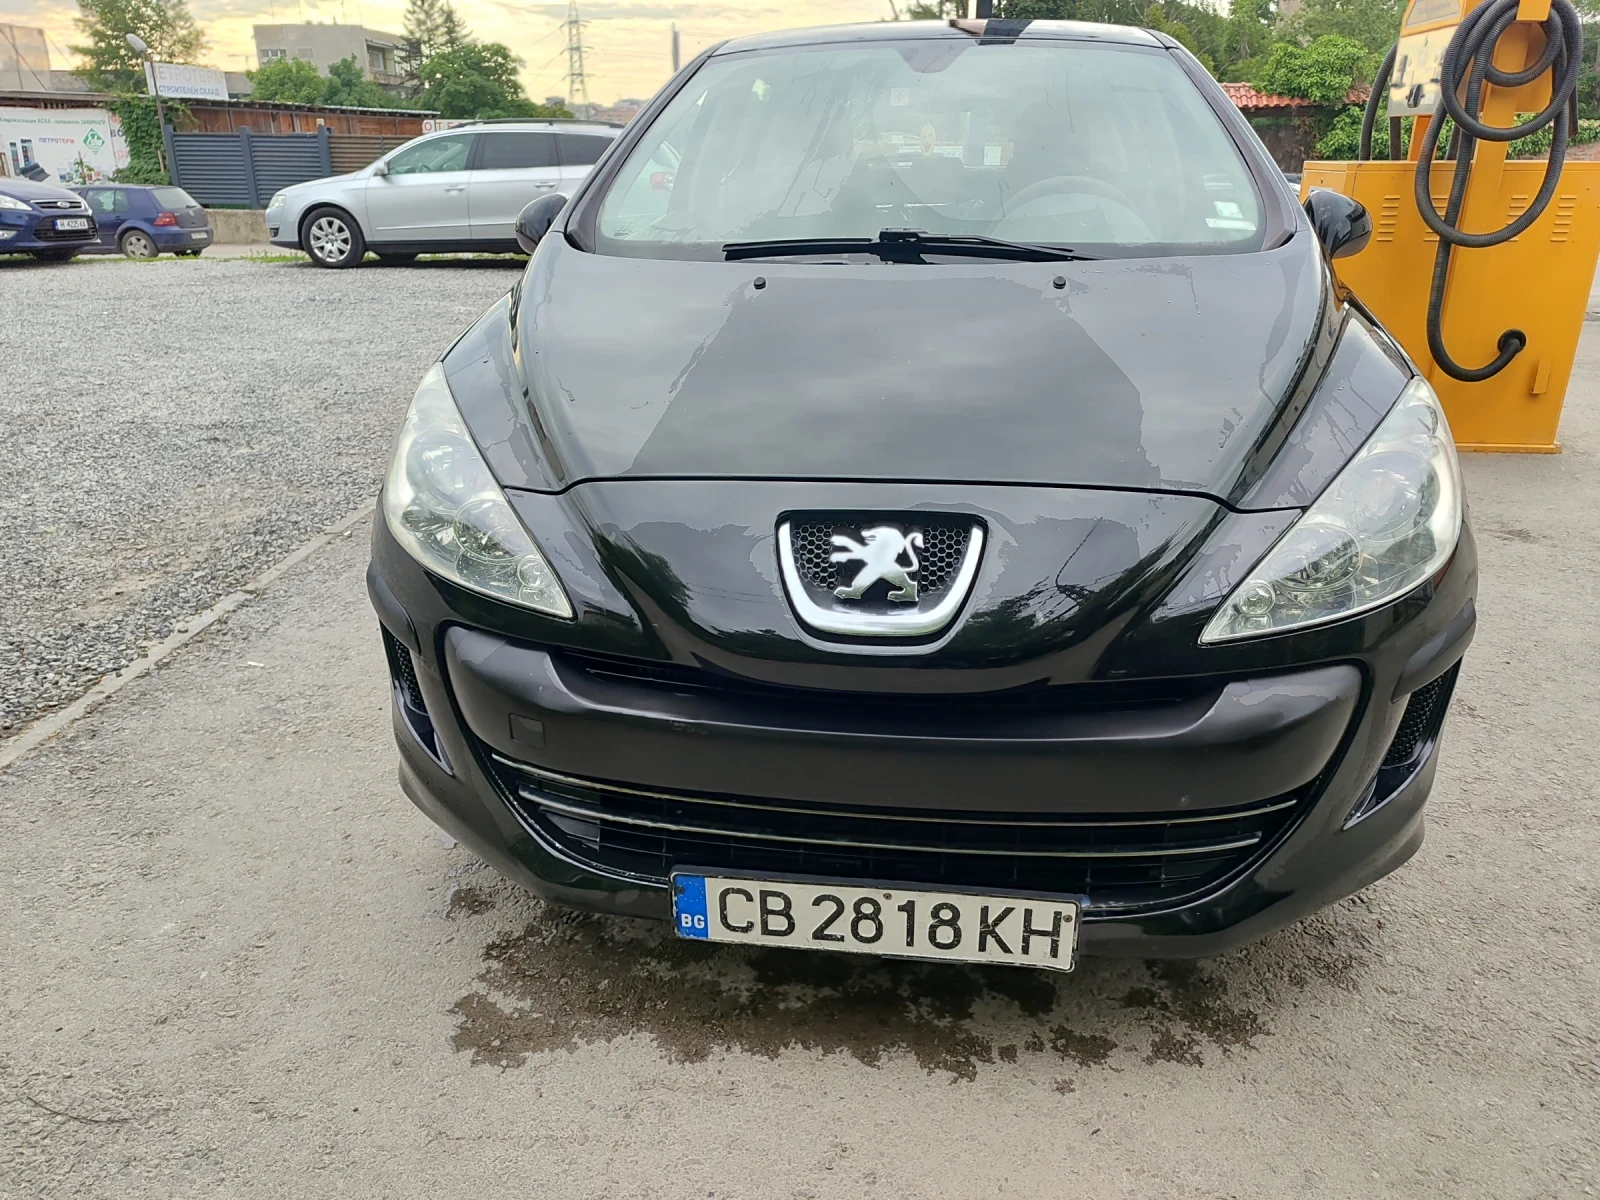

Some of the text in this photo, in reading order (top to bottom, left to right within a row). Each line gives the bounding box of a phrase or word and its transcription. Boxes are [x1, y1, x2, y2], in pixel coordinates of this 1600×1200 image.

[159, 84, 220, 96] СТРОИТЕЛЕН СКЛАД
[681, 912, 706, 929] BG
[718, 886, 1063, 959] CB 2818 KH
